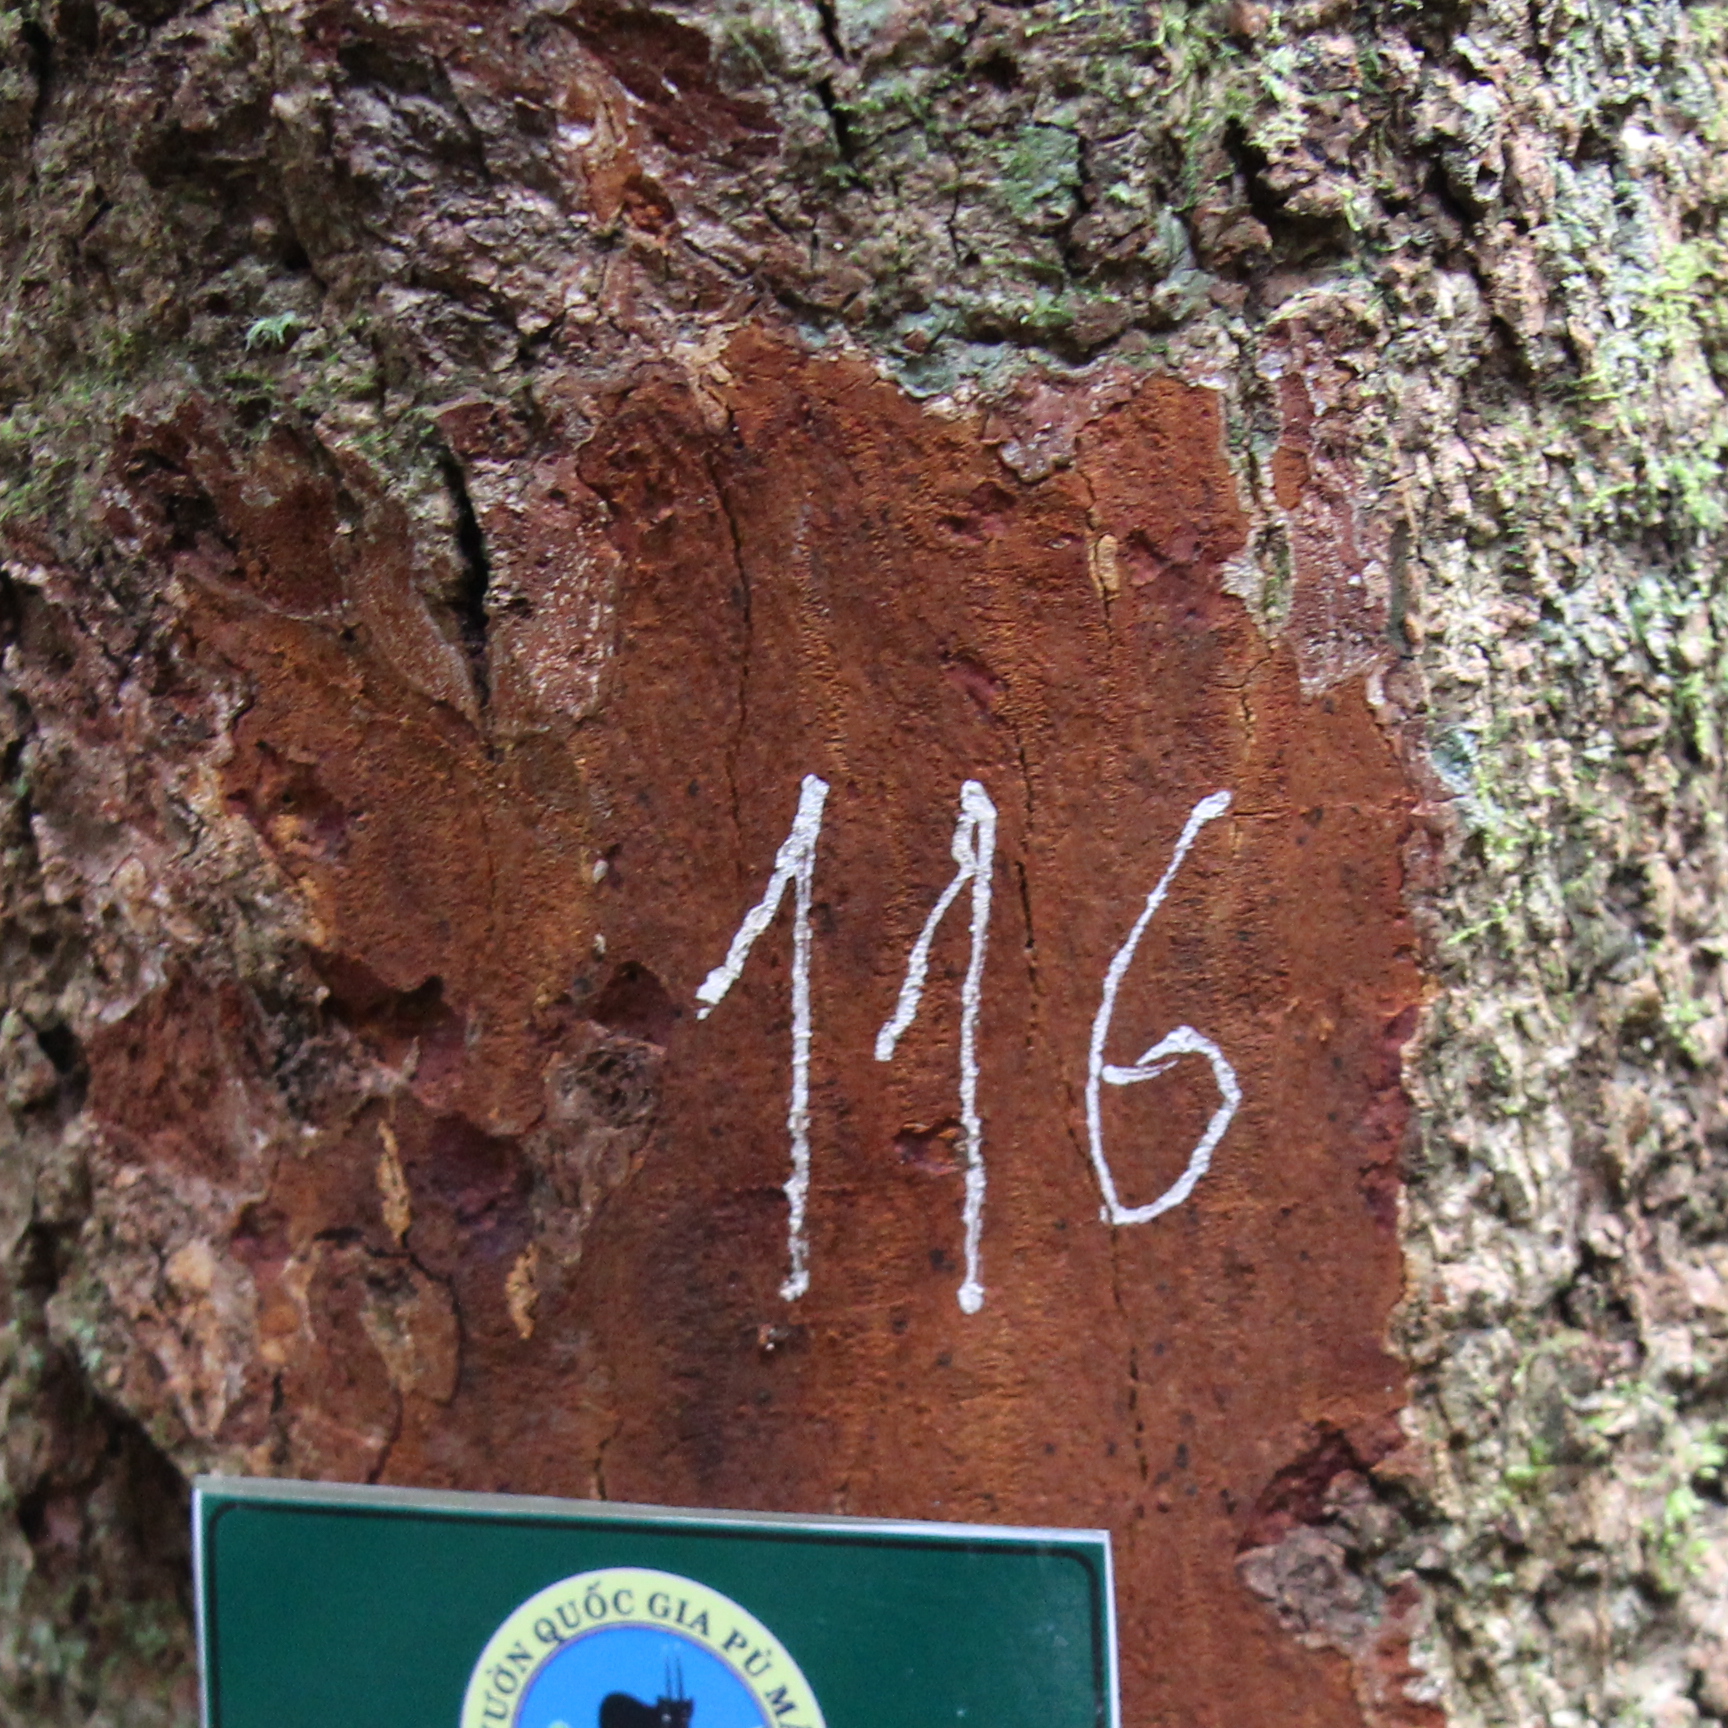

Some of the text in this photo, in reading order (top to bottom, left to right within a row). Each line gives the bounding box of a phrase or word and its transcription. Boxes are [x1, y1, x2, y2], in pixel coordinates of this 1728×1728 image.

[695, 774, 1243, 1314] 116
[534, 1580, 634, 1645] QUỐC
[647, 1592, 713, 1638] GIA
